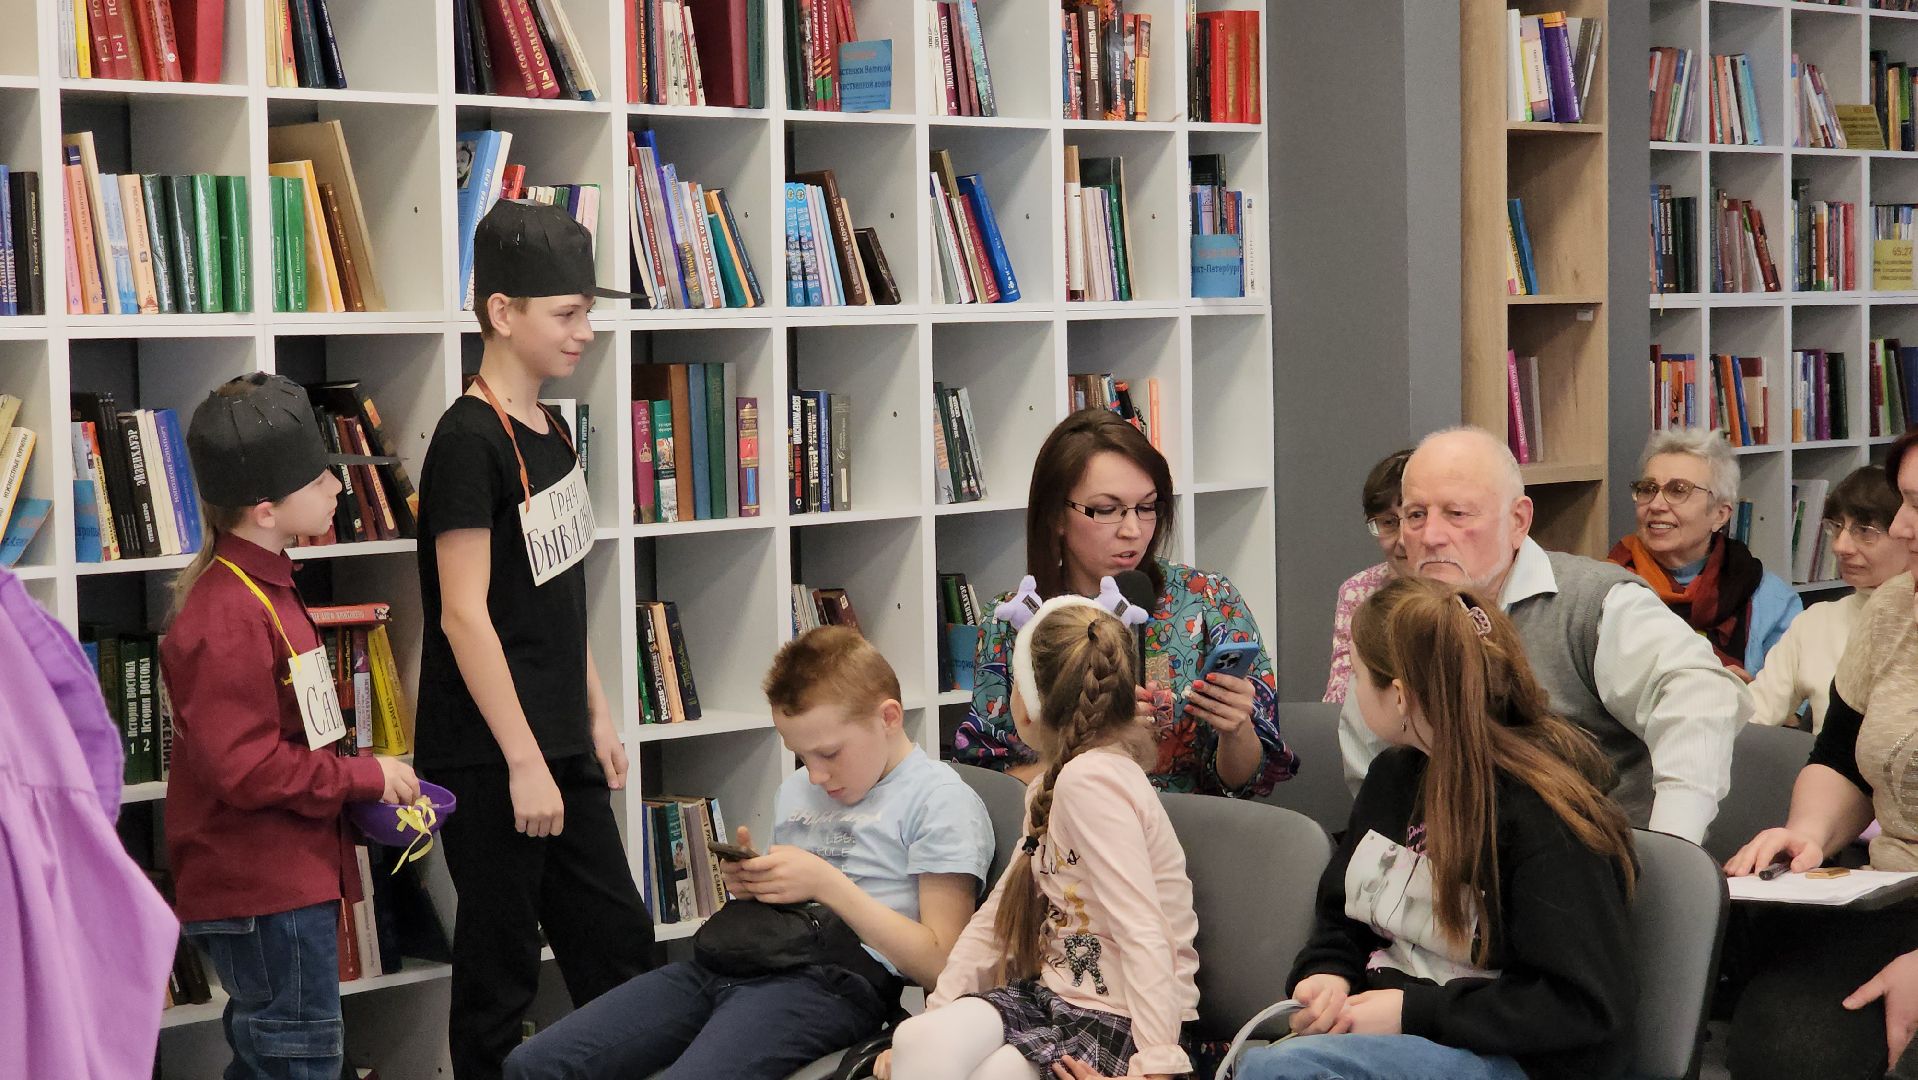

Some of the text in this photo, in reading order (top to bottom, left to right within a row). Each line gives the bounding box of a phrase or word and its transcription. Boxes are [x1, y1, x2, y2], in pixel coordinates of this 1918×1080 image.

[542, 71, 550, 81] 4
[692, 200, 720, 299] ГОРОД ЭТОТ СТАЛ СУДЬБОЮ
[124, 427, 147, 486] ЭЙЗЕНХАУЭР
[549, 481, 580, 521] ГРАЧ
[527, 489, 597, 577] БЫВАЛЫ
[957, 583, 975, 626] ЙЗЕНХАУЭР
[125, 660, 140, 738] История ВОСТОКА
[139, 657, 152, 733] История ВОСТОКА
[130, 742, 136, 755] 1
[143, 738, 151, 752] 2
